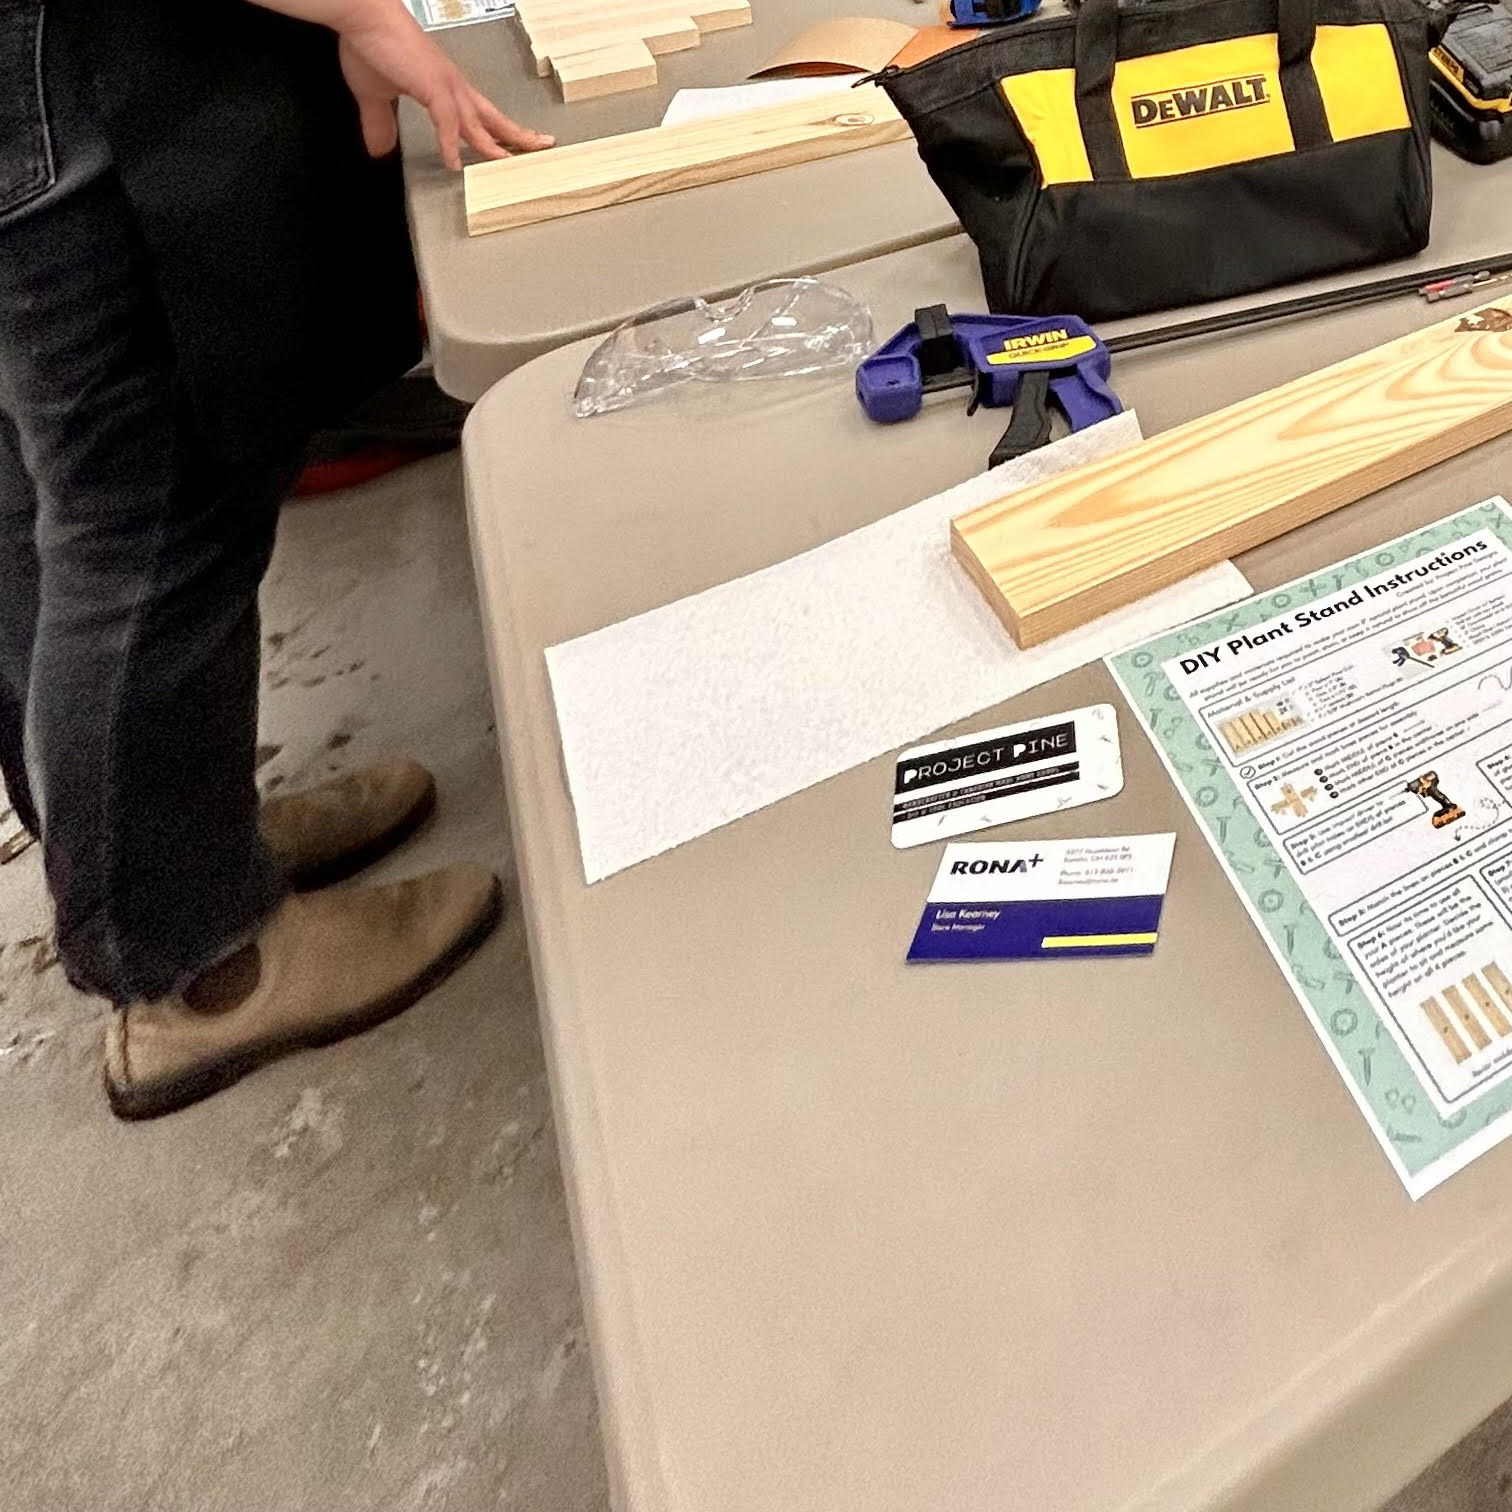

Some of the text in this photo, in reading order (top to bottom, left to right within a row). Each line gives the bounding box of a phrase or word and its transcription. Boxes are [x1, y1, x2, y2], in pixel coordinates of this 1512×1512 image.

[1132, 77, 1266, 125] DEWALT
[1004, 329, 1068, 350] IRWIN
[1178, 541, 1488, 675] DIY Plant Stand Instructions
[904, 733, 1069, 784] PROJECT PINE
[936, 909, 1001, 921] Lisa Kearney
